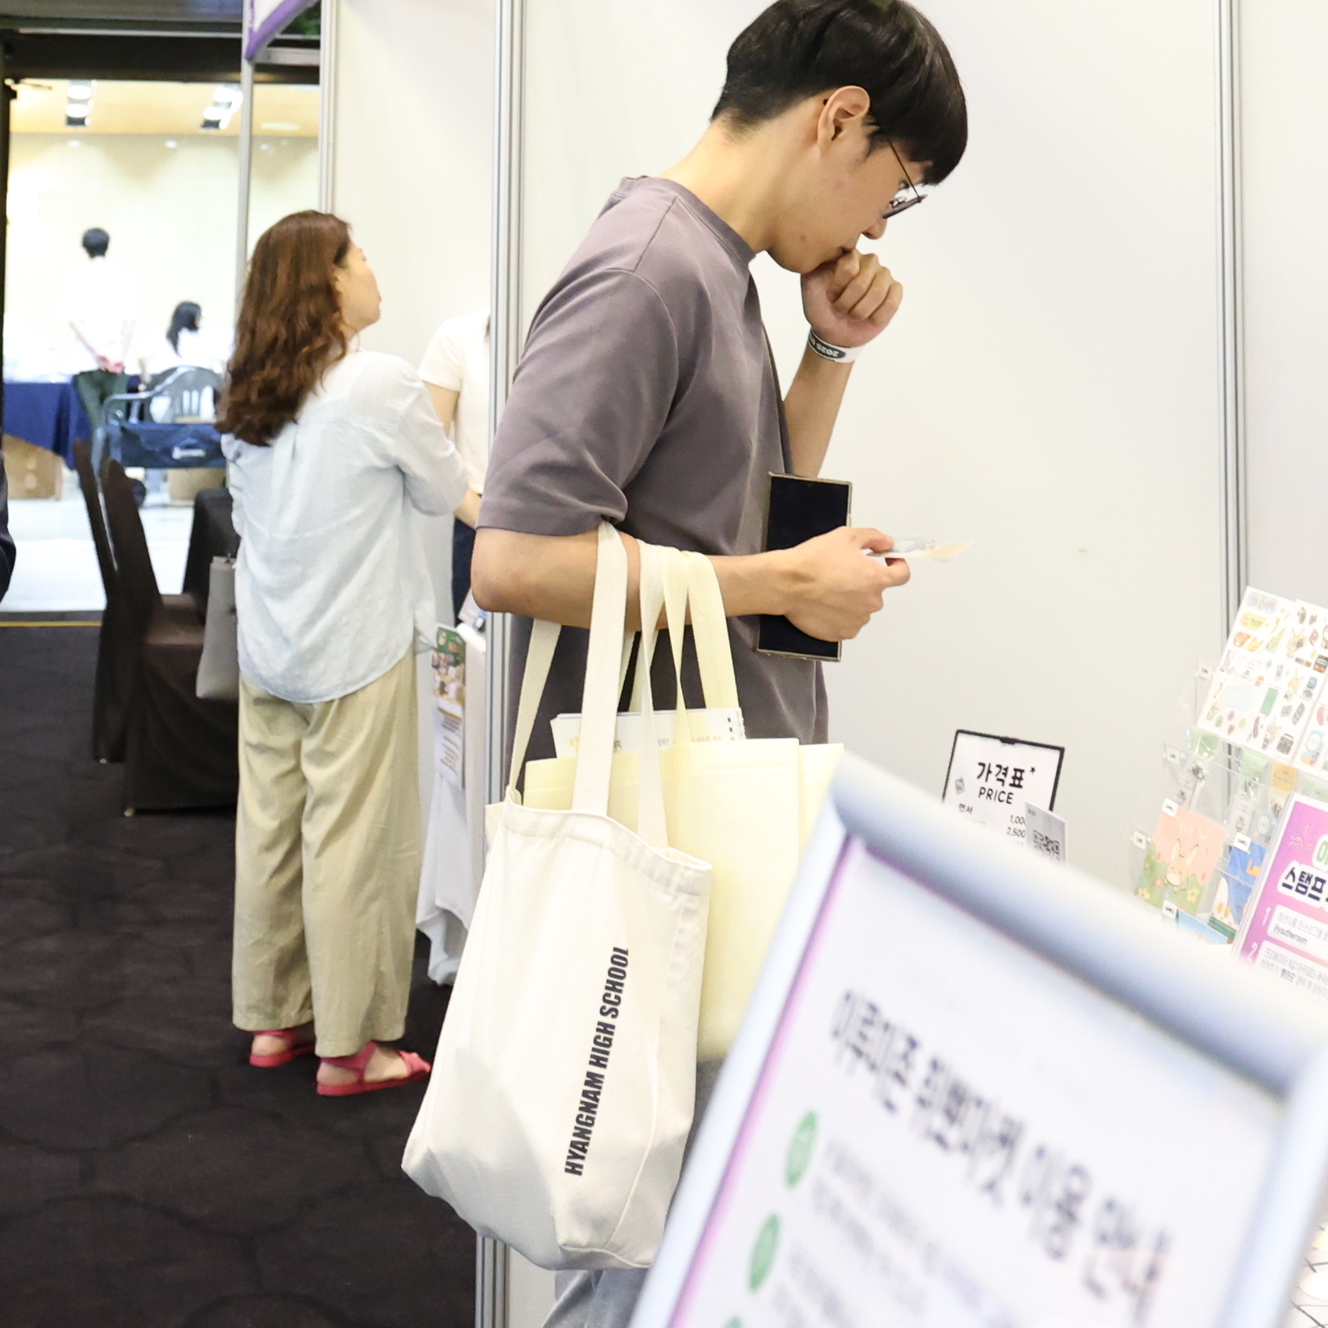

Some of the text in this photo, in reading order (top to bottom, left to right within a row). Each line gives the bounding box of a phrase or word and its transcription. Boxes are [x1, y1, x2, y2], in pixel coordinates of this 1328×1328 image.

[976, 761, 1026, 790] 가격표
[978, 786, 1015, 805] PRICE
[1281, 867, 1327, 902] 스탬프
[564, 946, 630, 1176] HYANGNAM HIGH SCHOOL
